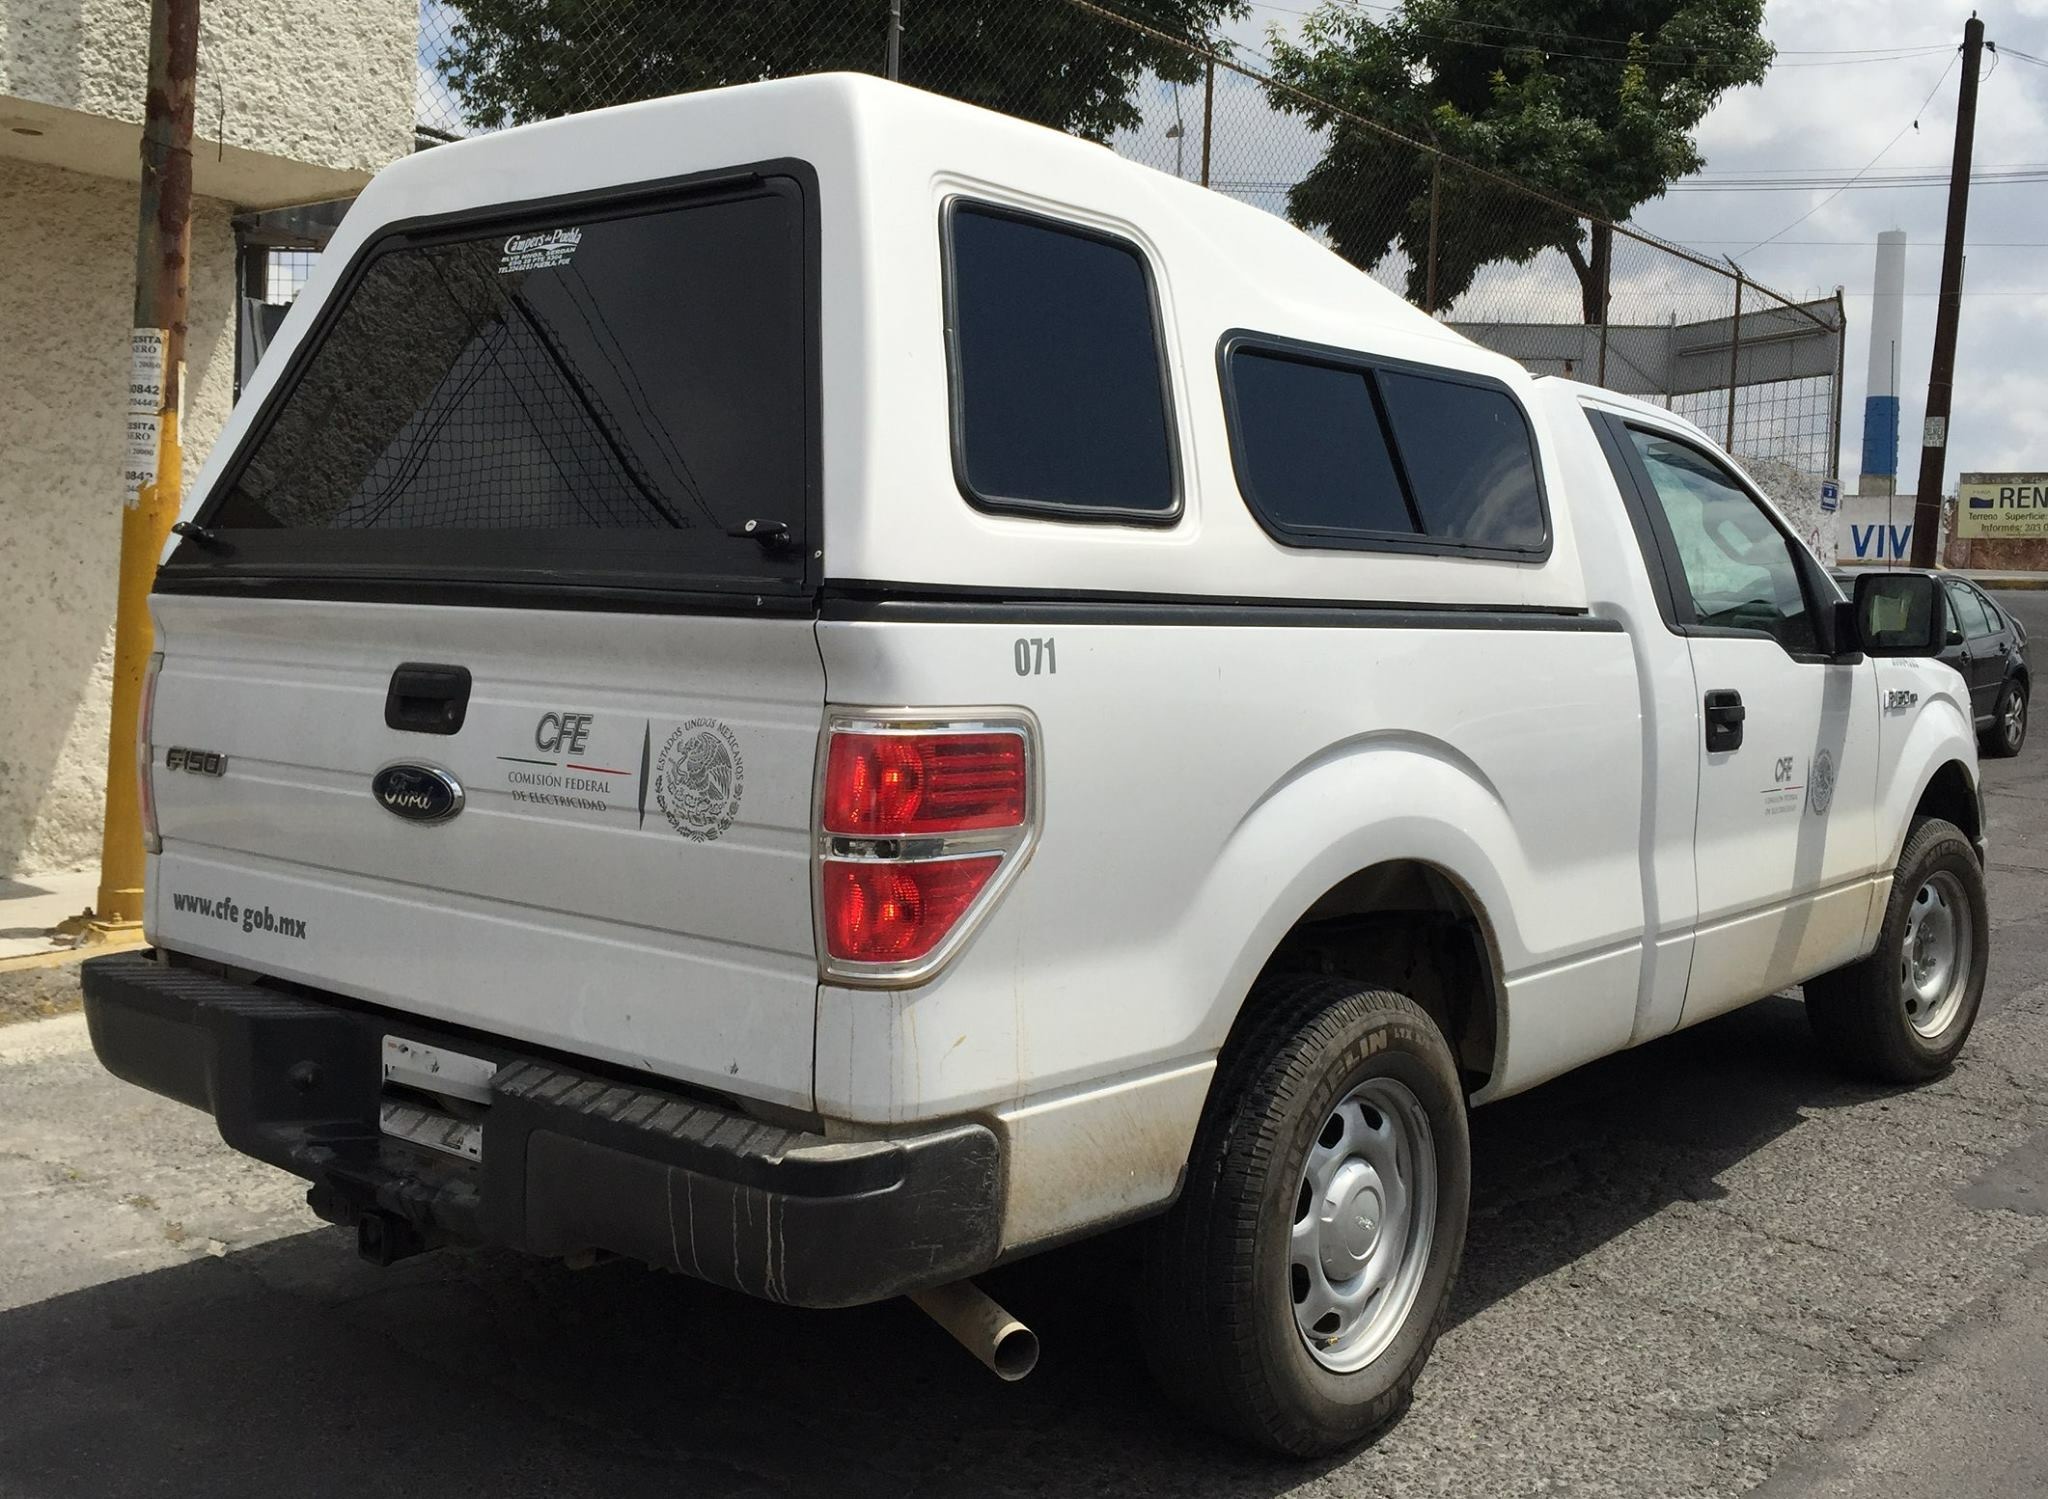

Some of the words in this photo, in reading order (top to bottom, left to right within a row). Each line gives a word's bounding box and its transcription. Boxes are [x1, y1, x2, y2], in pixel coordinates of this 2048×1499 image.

[504, 234, 545, 254] Campers
[551, 227, 582, 244] Puebla
[1999, 487, 2048, 508] REN
[1969, 512, 1998, 520] Terreno
[1851, 525, 1913, 558] VIV
[1014, 637, 1056, 676] 071
[535, 711, 594, 755] CFE
[657, 727, 682, 771] ESTADOS
[684, 718, 717, 731] UNIDOS
[717, 722, 744, 780] MEXICANOS
[565, 776, 611, 793] FEDERAL
[512, 790, 527, 801] DE
[530, 792, 607, 812] ELECTRICIDAD
